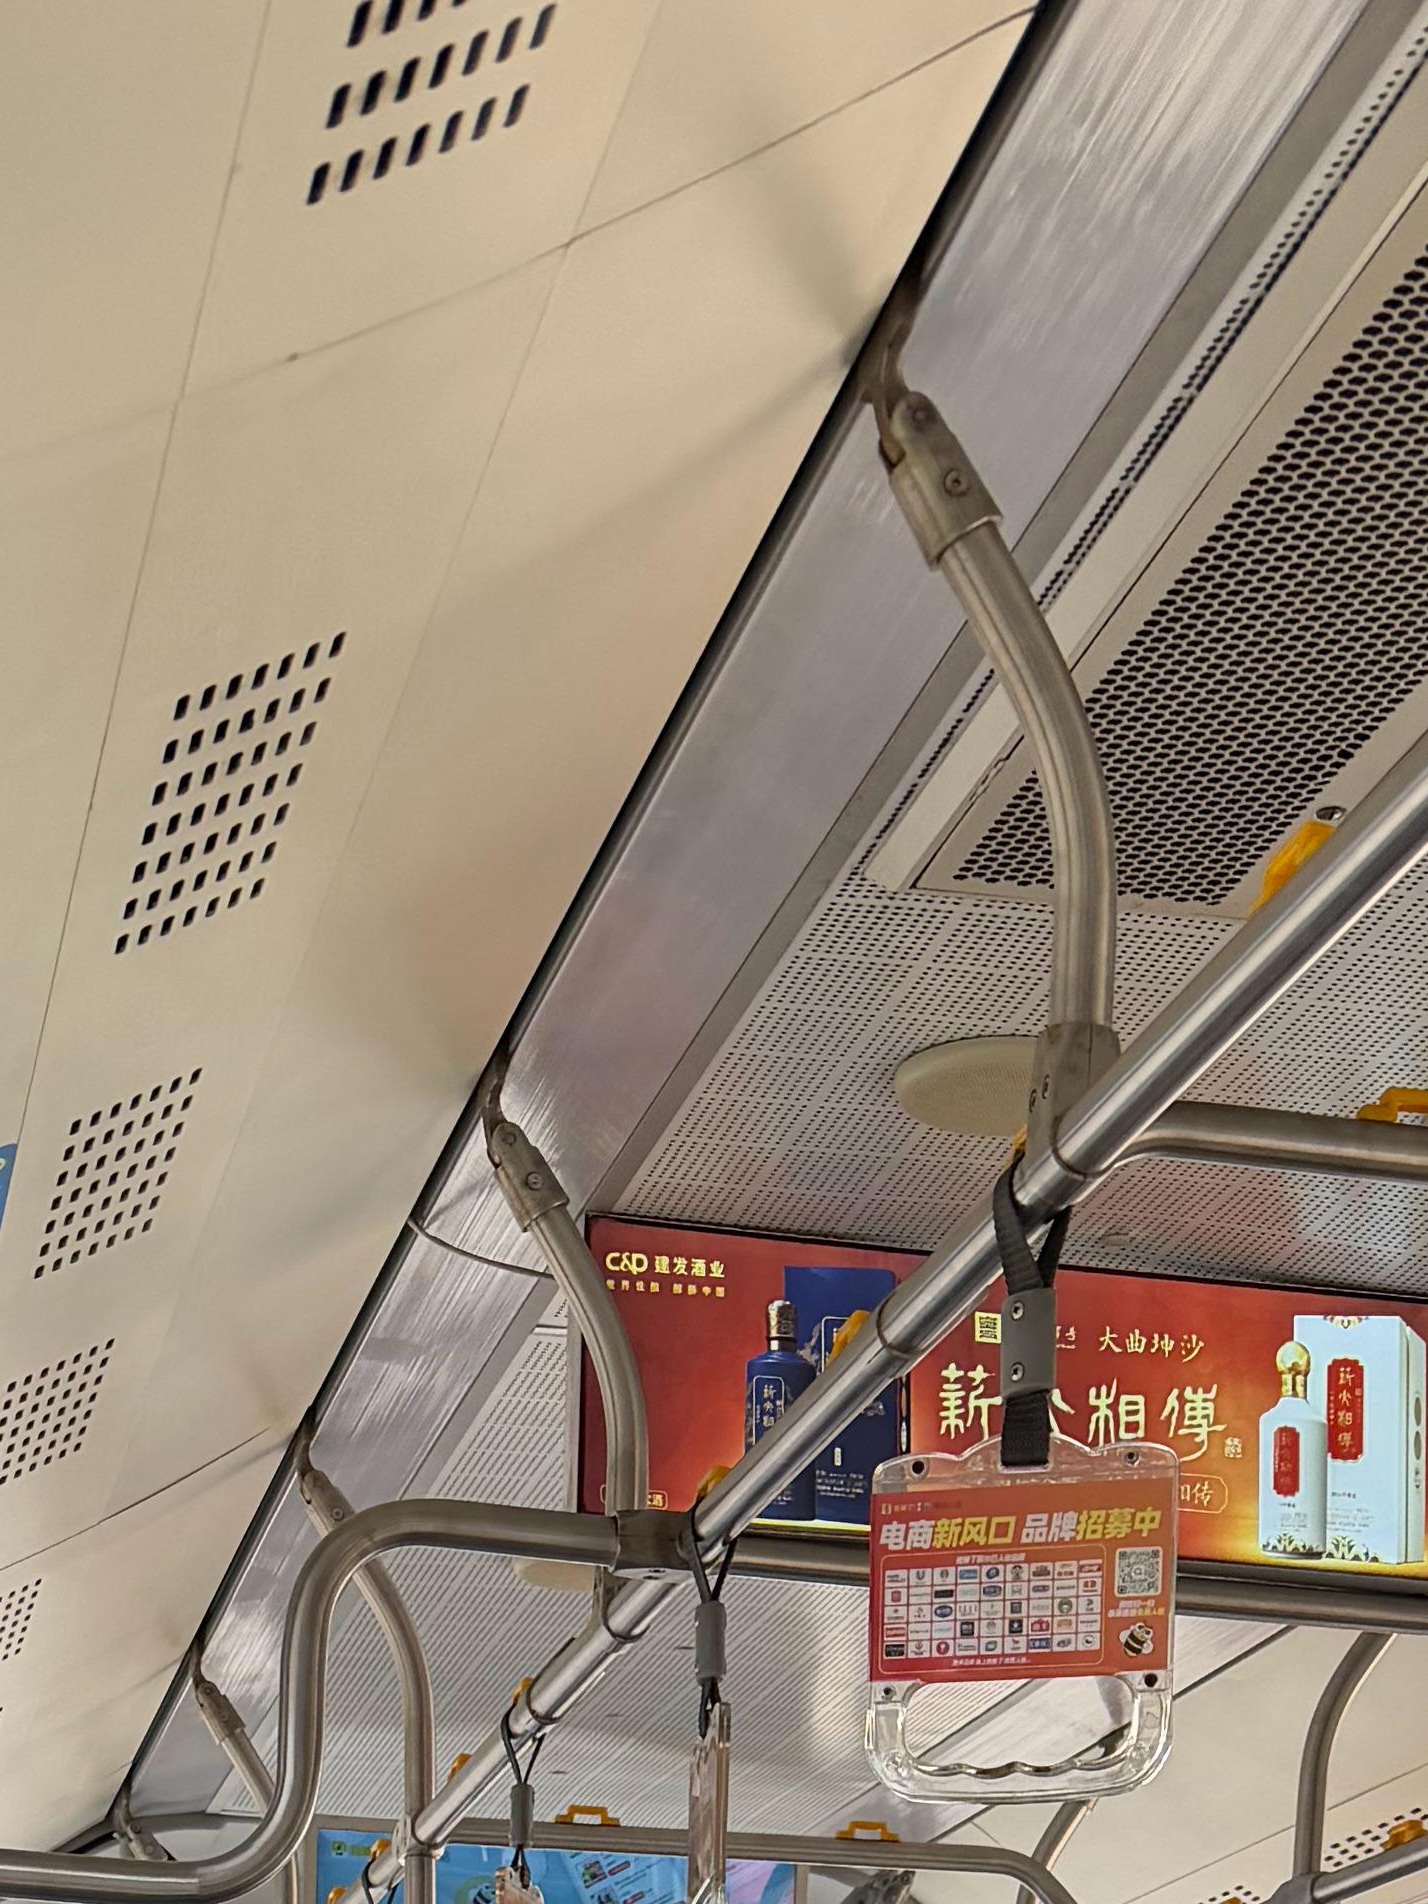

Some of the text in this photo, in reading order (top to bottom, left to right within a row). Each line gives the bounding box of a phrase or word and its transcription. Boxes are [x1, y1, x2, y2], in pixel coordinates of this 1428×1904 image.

[606, 1252, 648, 1275] C&D
[655, 1256, 725, 1278] 建发酒业
[879, 1506, 1163, 1550] 电商新风口 品牌招募中
